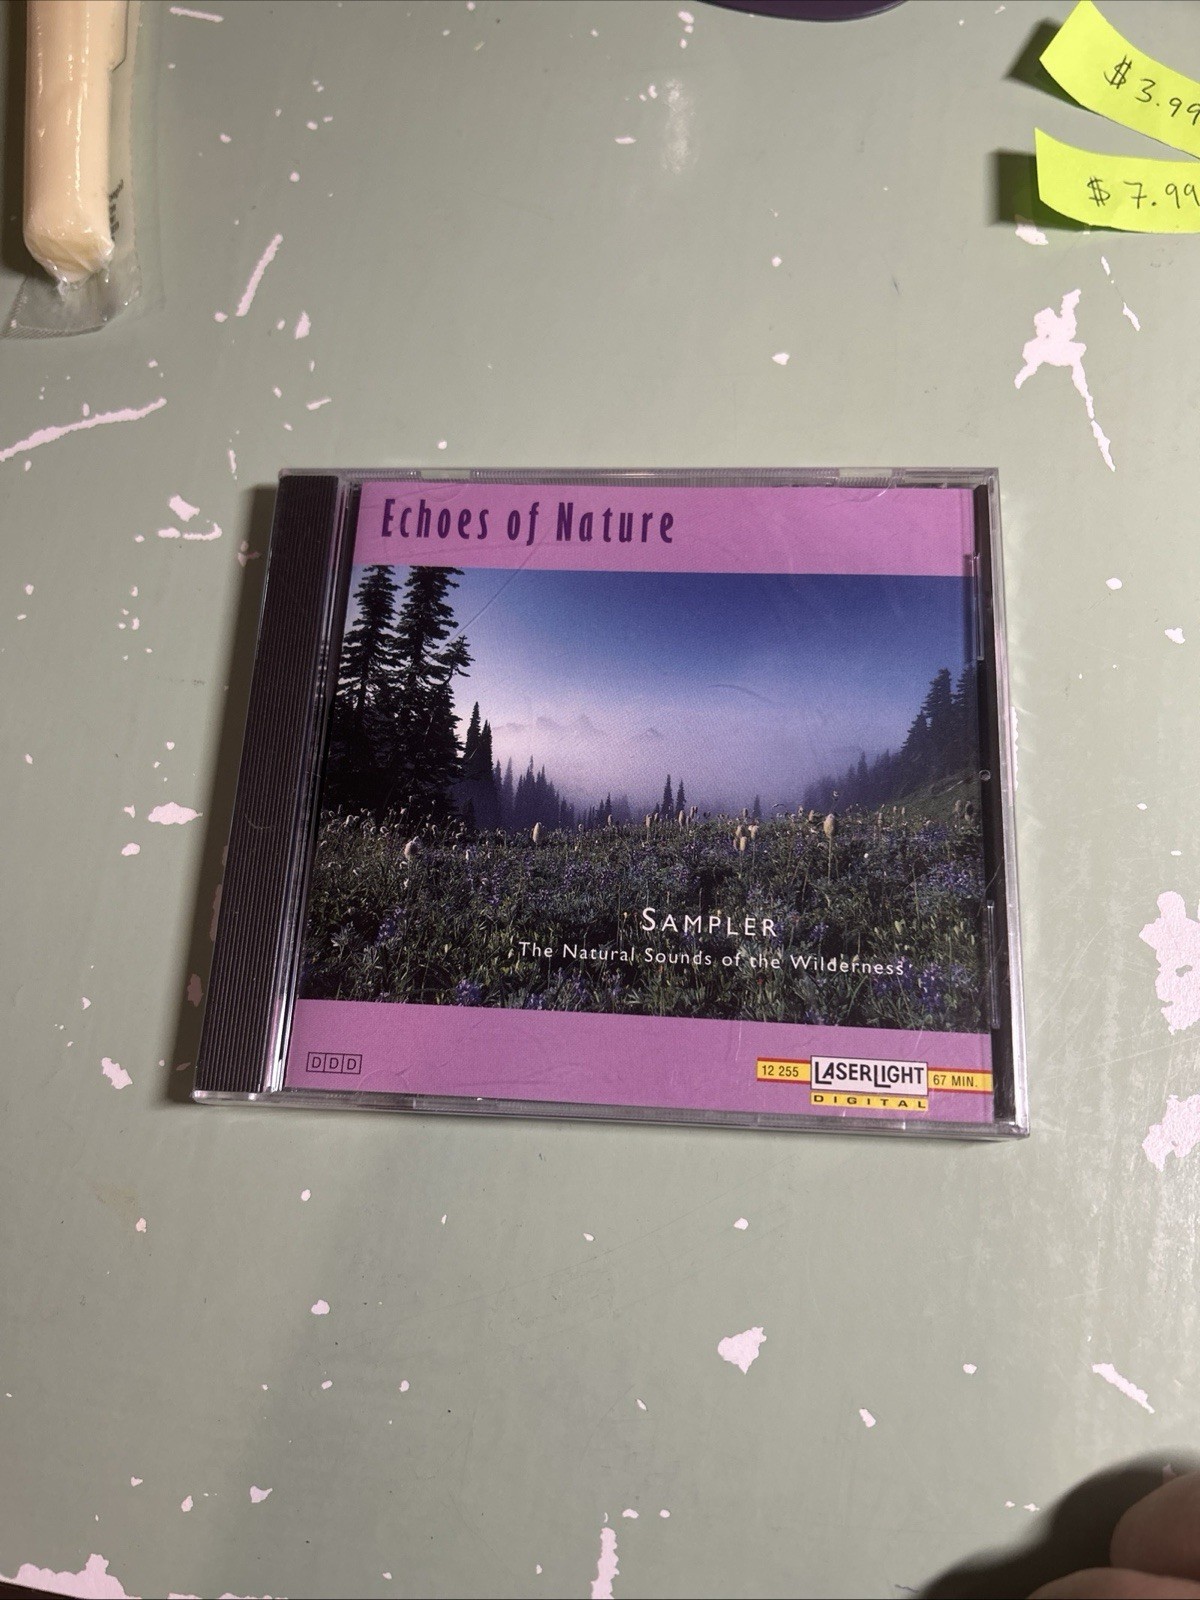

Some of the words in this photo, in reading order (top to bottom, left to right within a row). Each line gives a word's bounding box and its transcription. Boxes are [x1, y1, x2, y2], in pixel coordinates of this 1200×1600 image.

[381, 498, 490, 540] Echoes
[506, 501, 540, 546] of
[556, 502, 675, 544] Nature
[641, 906, 778, 937] SAMPLER
[519, 941, 554, 958] The
[562, 943, 635, 962] Natural
[644, 947, 713, 966] Sounds
[721, 952, 742, 967] of
[749, 953, 781, 969] the
[790, 954, 905, 976] Wilderness
[761, 1064, 775, 1076] 12
[778, 1065, 800, 1077] 255
[933, 1074, 946, 1086] 67
[951, 1075, 979, 1088] MIN.
[813, 1094, 927, 1109] DIGITAL
